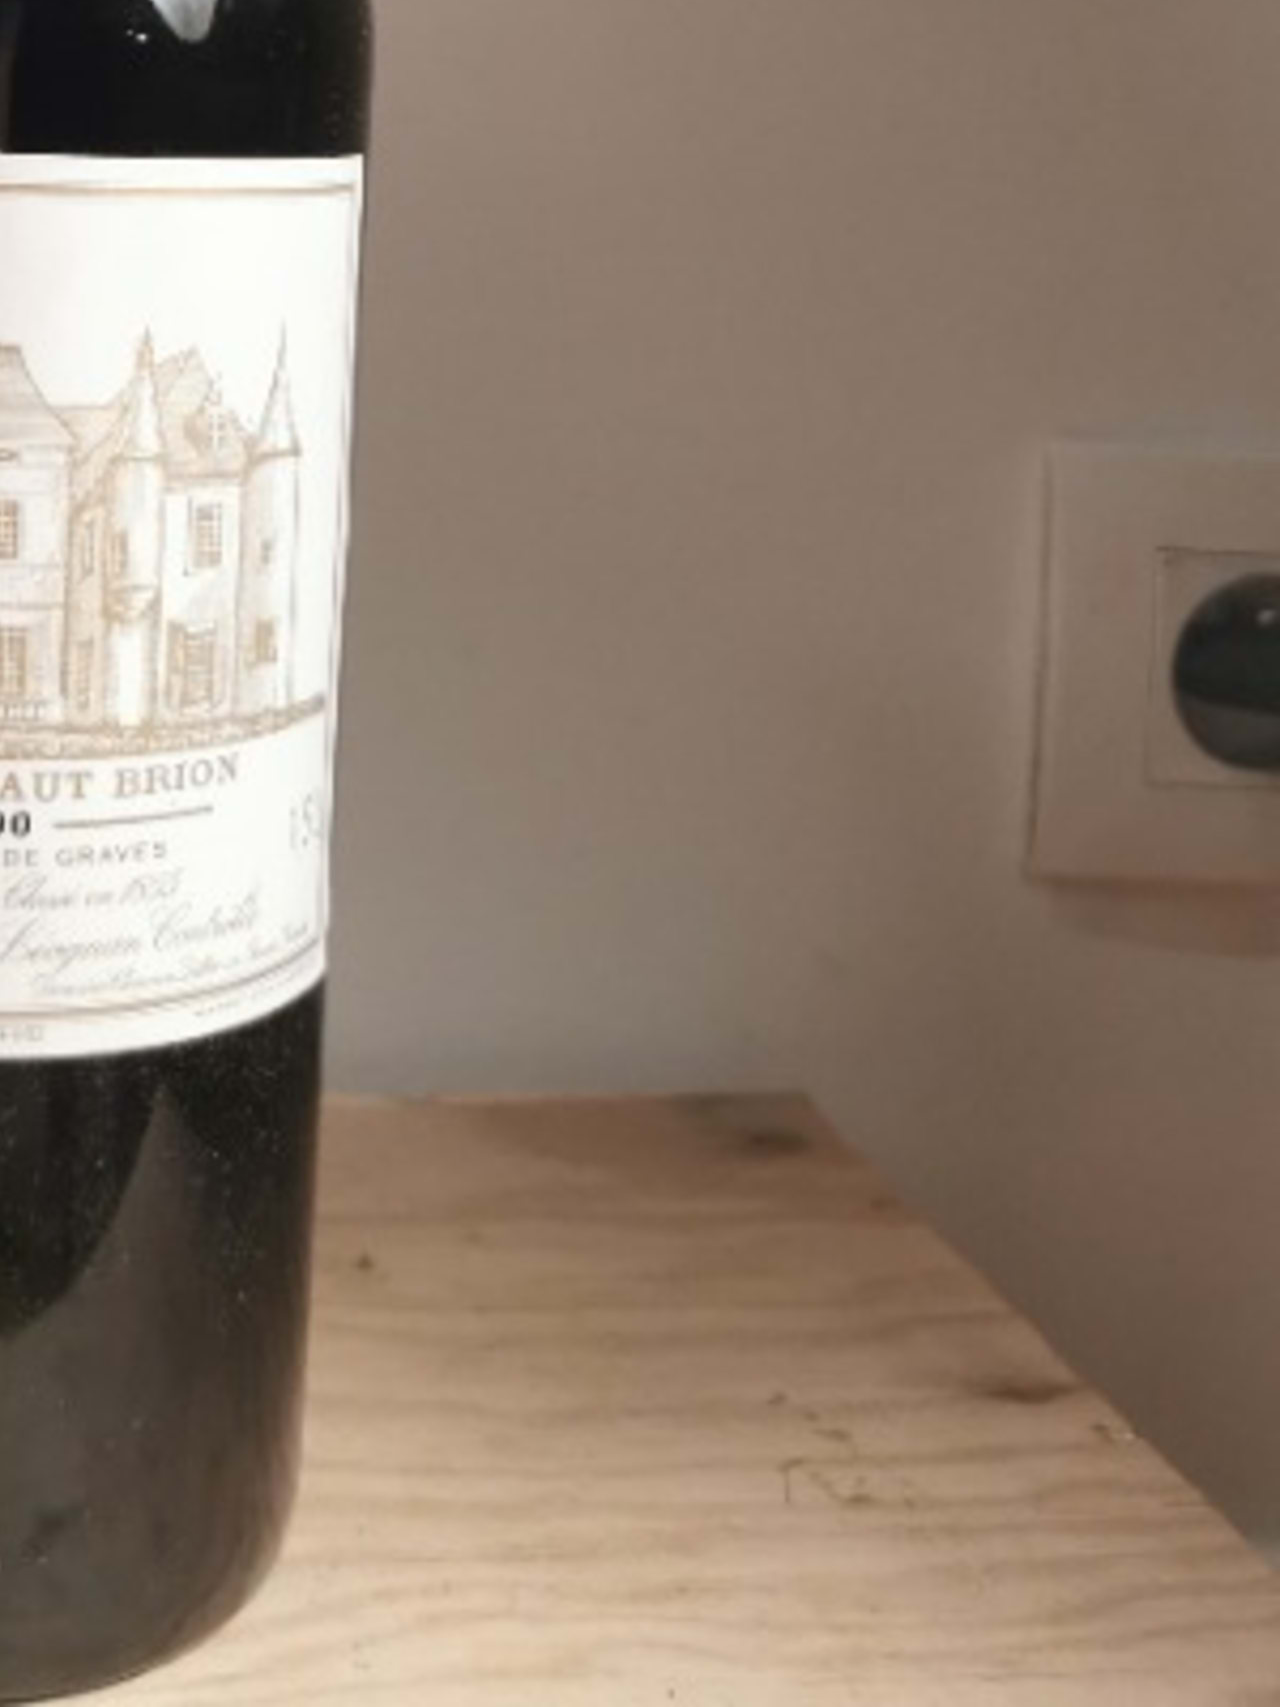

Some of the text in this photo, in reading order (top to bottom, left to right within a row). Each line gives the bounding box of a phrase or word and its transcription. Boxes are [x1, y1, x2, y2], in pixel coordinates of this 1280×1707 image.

[113, 752, 240, 800] BRION
[2, 848, 39, 868] DE
[53, 840, 168, 868] GRAVES
